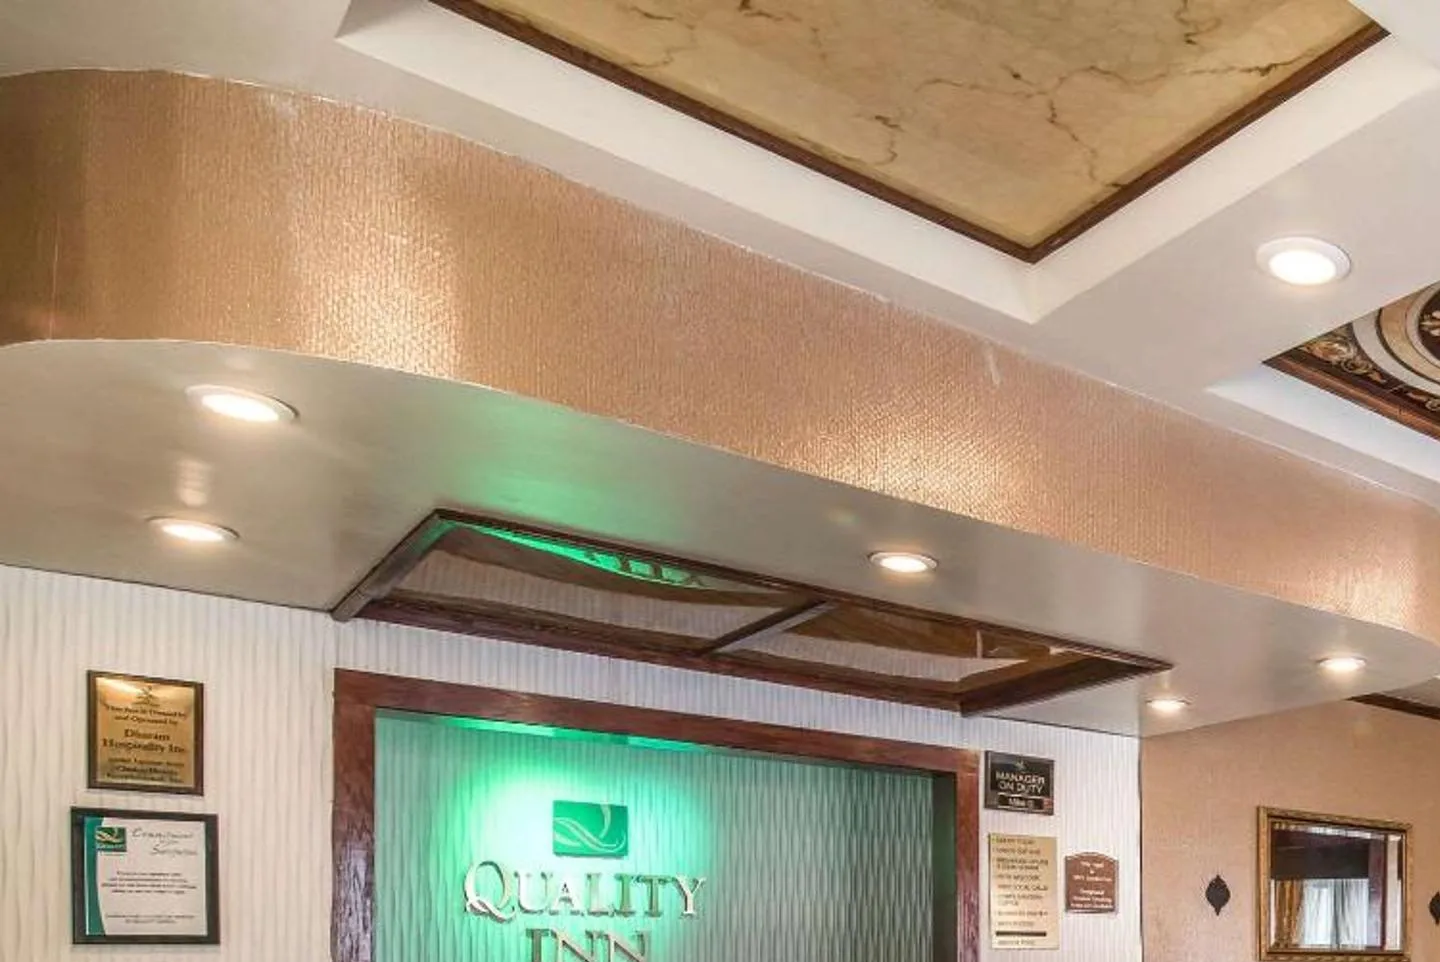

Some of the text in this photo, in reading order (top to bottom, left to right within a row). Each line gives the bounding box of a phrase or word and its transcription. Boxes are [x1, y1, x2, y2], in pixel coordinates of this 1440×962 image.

[995, 770, 1046, 785] MANAGER
[998, 780, 1043, 794] ON DUTY
[463, 859, 707, 924] QUALITY
